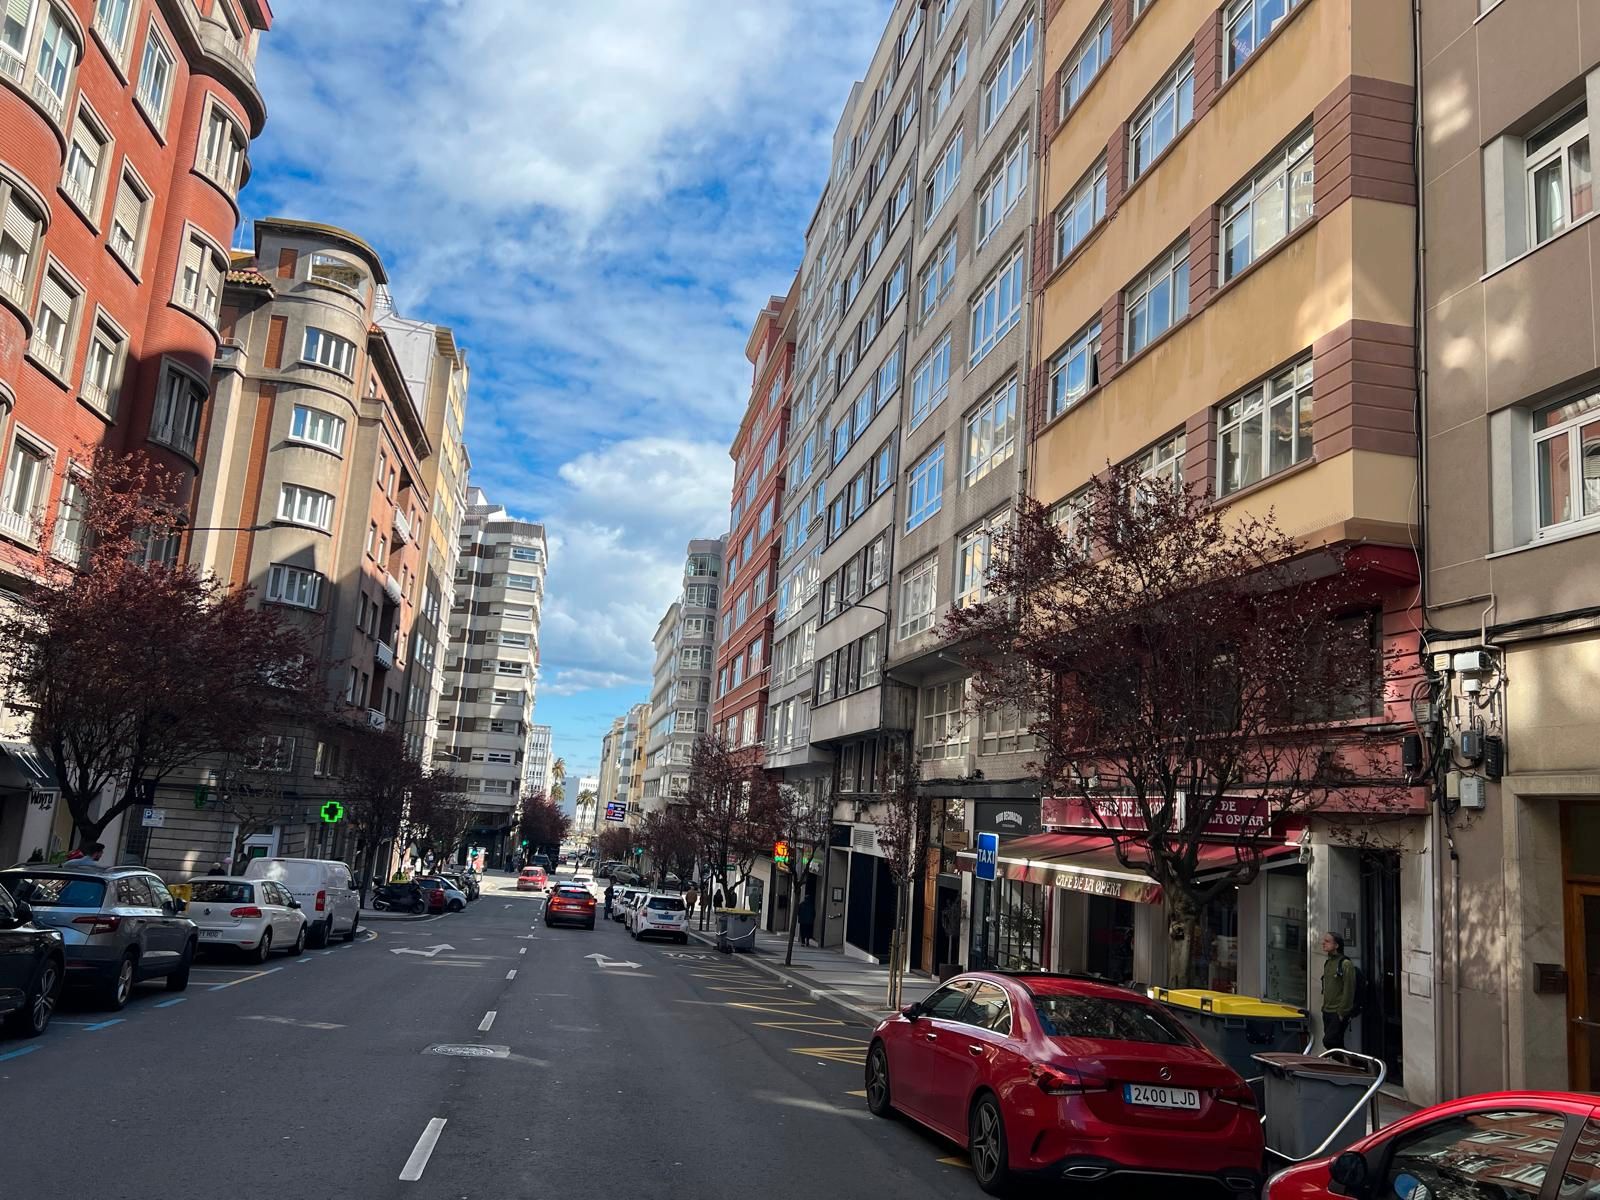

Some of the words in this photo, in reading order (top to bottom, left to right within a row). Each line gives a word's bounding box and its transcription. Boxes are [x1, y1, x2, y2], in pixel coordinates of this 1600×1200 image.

[1220, 800, 1237, 812] DE
[978, 848, 995, 865] TAXI
[1073, 876, 1084, 890] DE
[1084, 877, 1095, 892] LA
[1134, 1087, 1167, 1104] 2400
[1170, 1090, 1196, 1106] LJD
